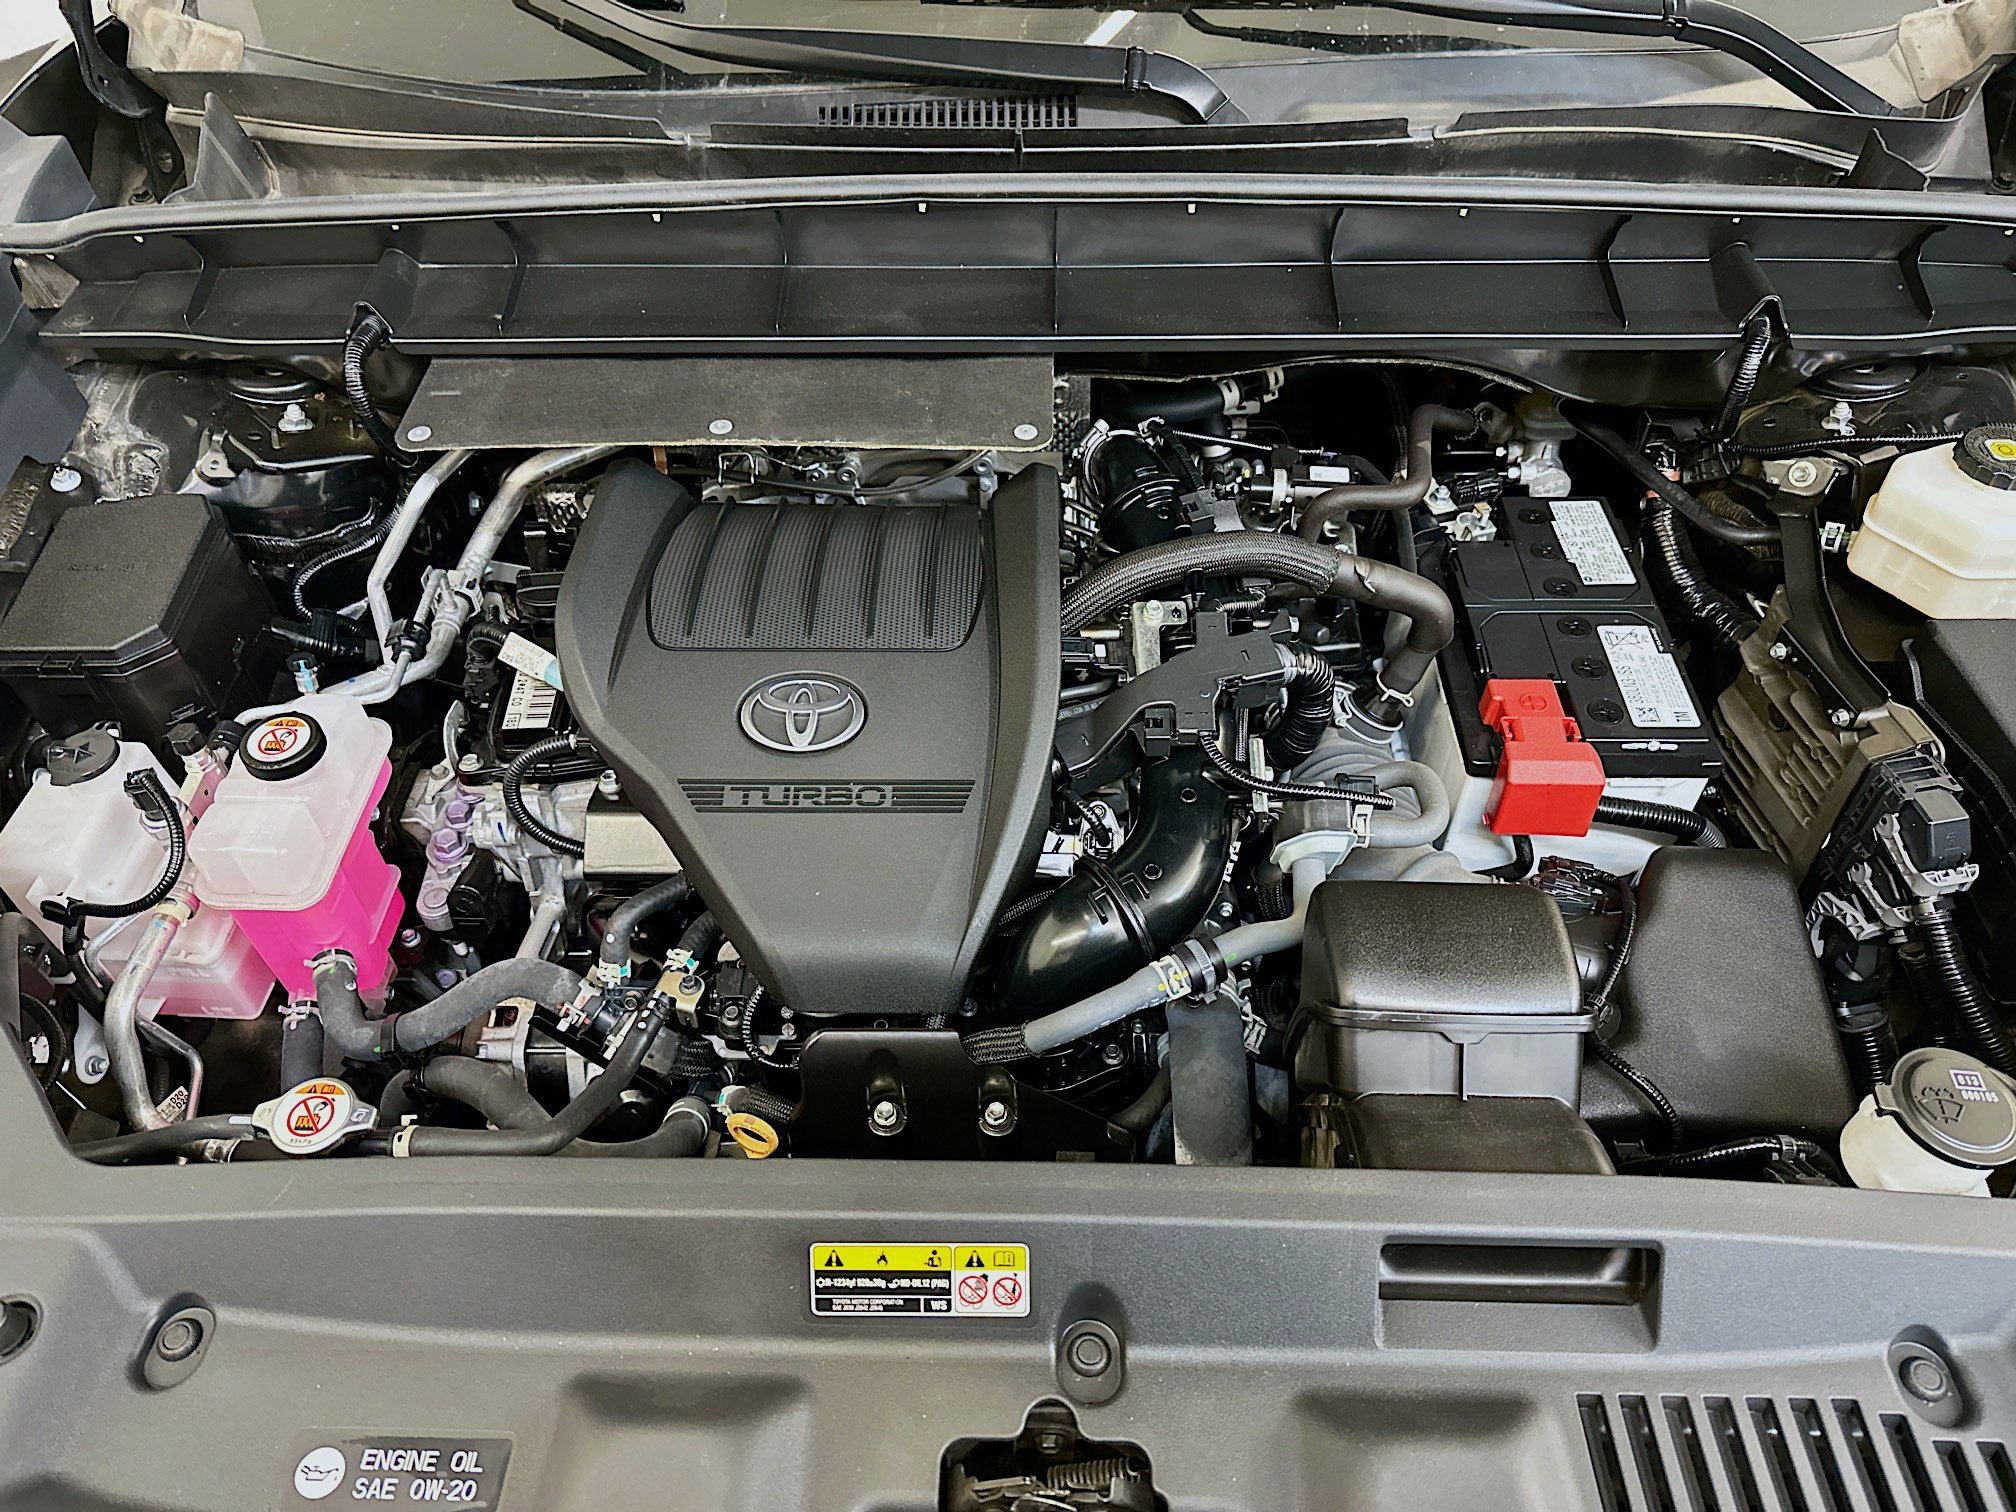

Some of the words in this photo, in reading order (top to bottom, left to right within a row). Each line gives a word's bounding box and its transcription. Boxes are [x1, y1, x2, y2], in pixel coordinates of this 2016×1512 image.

[1673, 711, 1692, 723] TM
[730, 786, 887, 806] TURBO
[170, 1090, 184, 1104] D20
[869, 1298, 904, 1306] CORPORATION
[930, 1300, 948, 1311] WS
[359, 1449, 440, 1472] ENGINE
[450, 1451, 483, 1473] OIL
[352, 1478, 399, 1500] SAE
[409, 1479, 477, 1501] 0W-20
